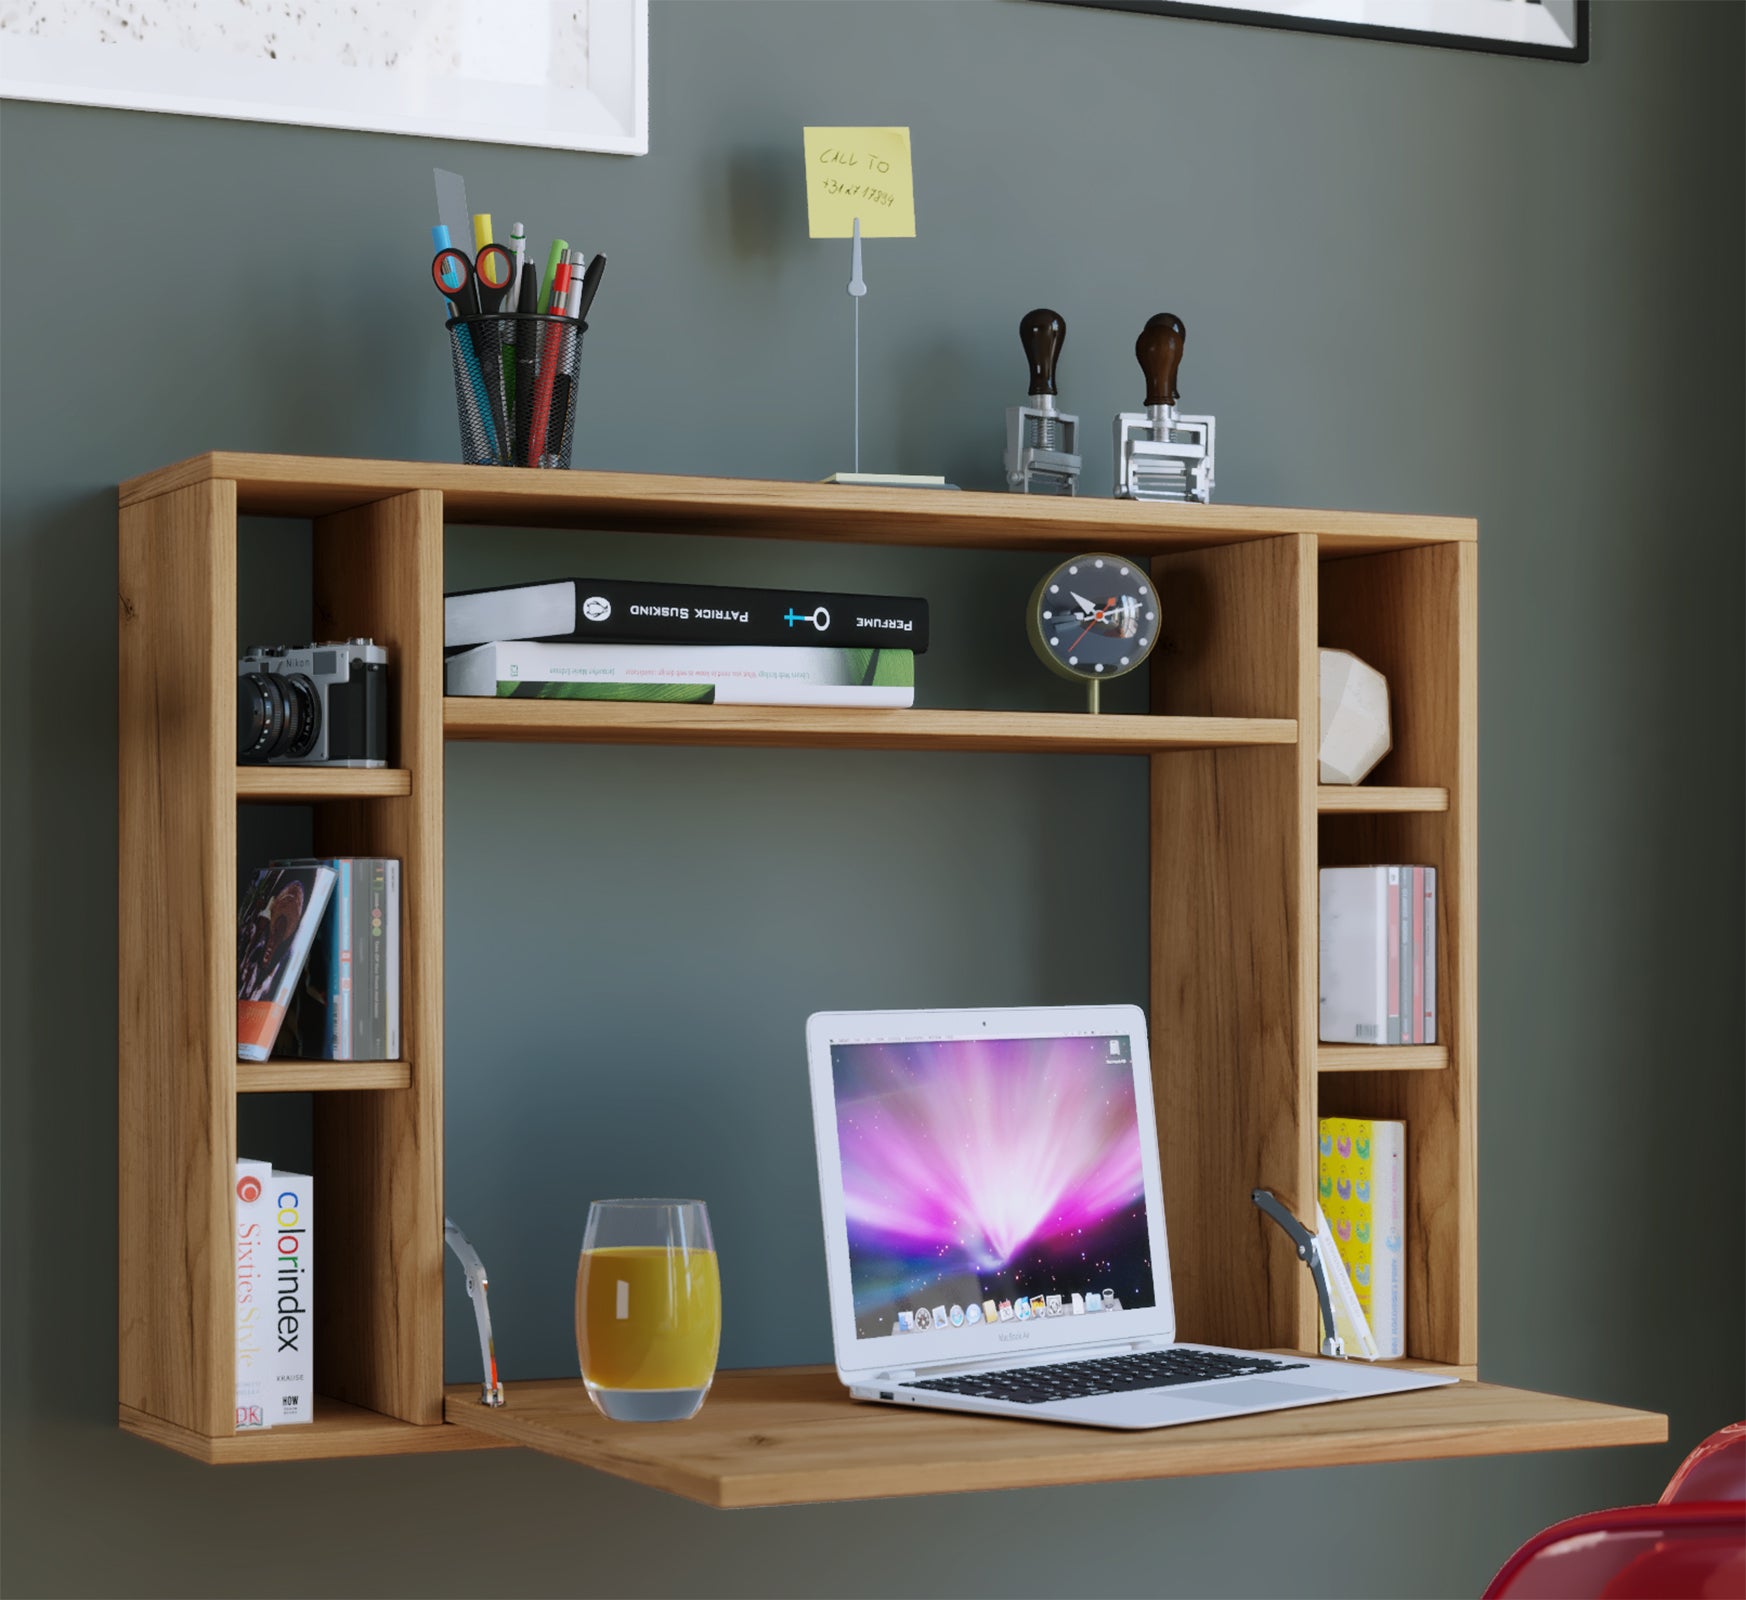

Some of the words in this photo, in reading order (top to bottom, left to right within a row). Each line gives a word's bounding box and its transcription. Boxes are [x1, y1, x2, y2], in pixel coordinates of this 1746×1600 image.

[819, 148, 858, 166] CALL
[868, 153, 890, 173] TO
[630, 604, 689, 619] SUSKIND
[695, 608, 749, 622] PATRICK
[856, 617, 913, 631] PERFUME
[286, 659, 310, 668] Nikon
[278, 1192, 306, 1352] colorindex
[282, 1396, 298, 1406] HOW
[236, 1406, 261, 1424] DK
